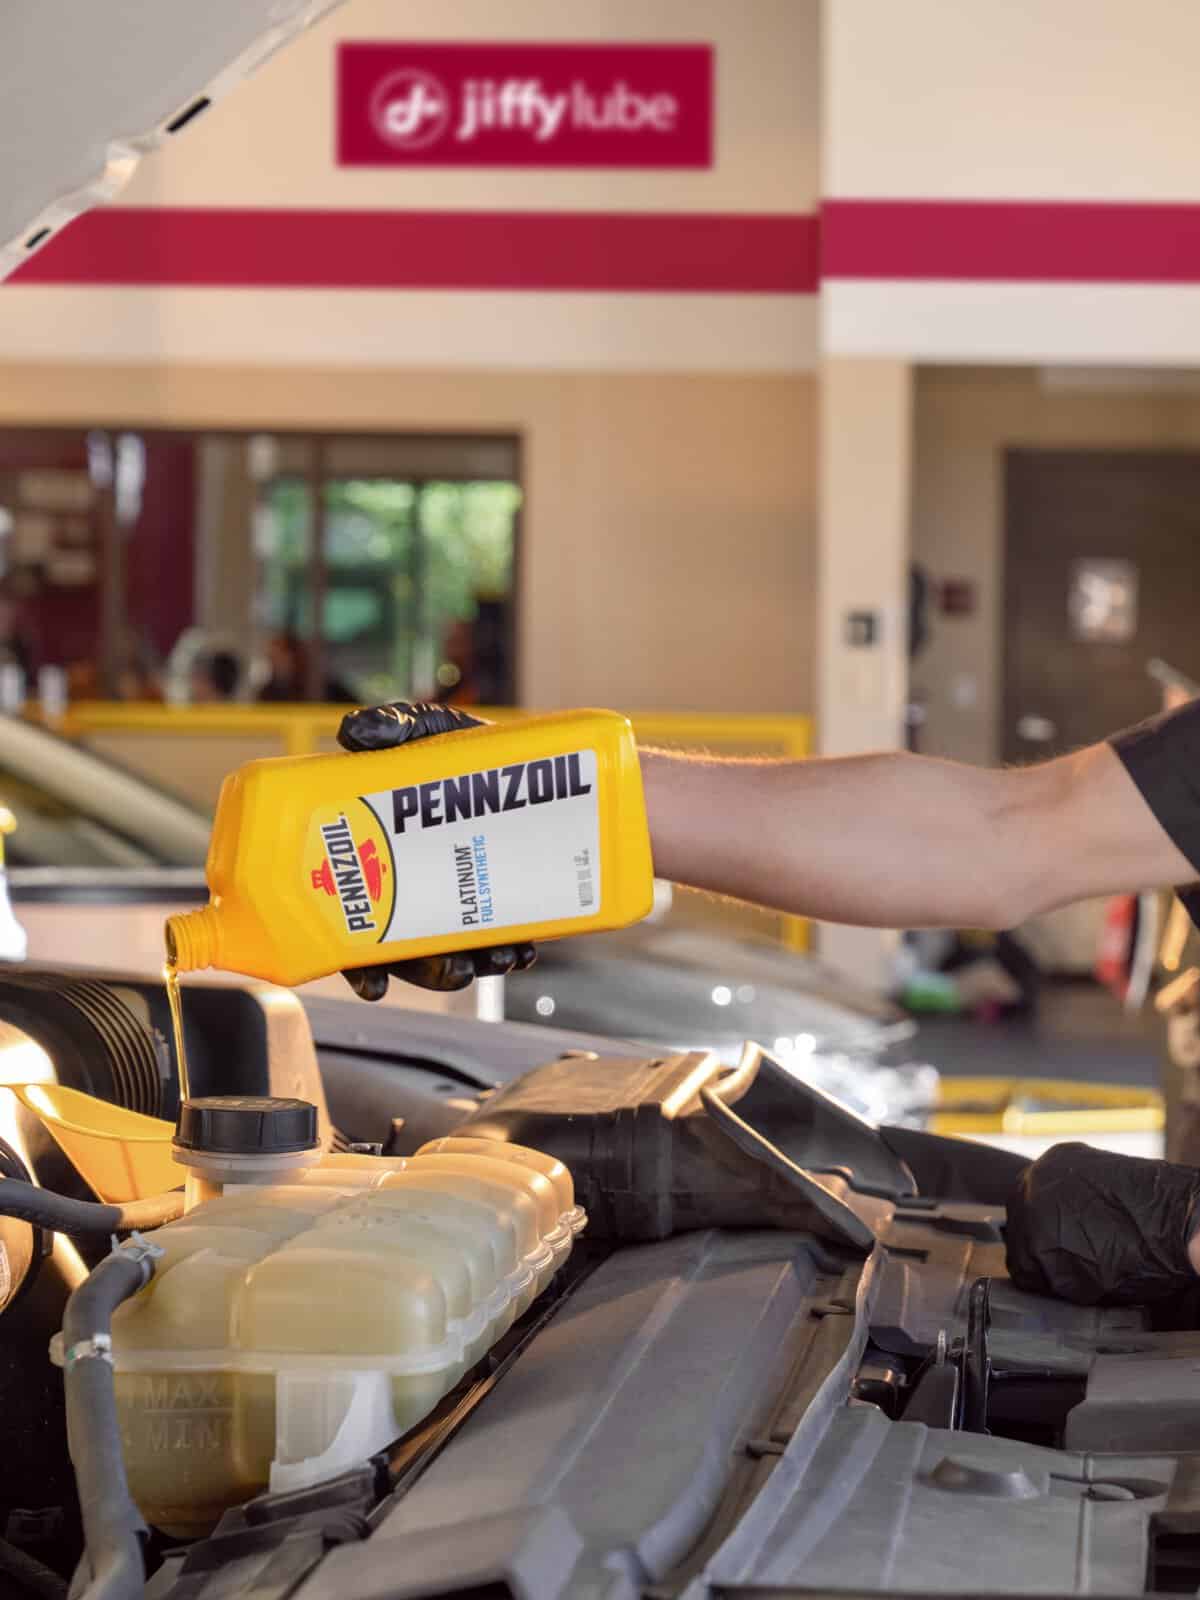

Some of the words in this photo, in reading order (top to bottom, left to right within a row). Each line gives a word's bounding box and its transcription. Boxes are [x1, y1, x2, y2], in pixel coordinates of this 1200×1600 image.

[393, 753, 592, 834] PENNZOIL
[322, 818, 376, 932] PENNZOIL
[454, 846, 479, 926] PLATINUM
[472, 834, 491, 895] SYNTHETIC
[480, 895, 495, 923] FULL
[145, 1375, 221, 1409] MAX
[149, 1418, 222, 1450] MIN
